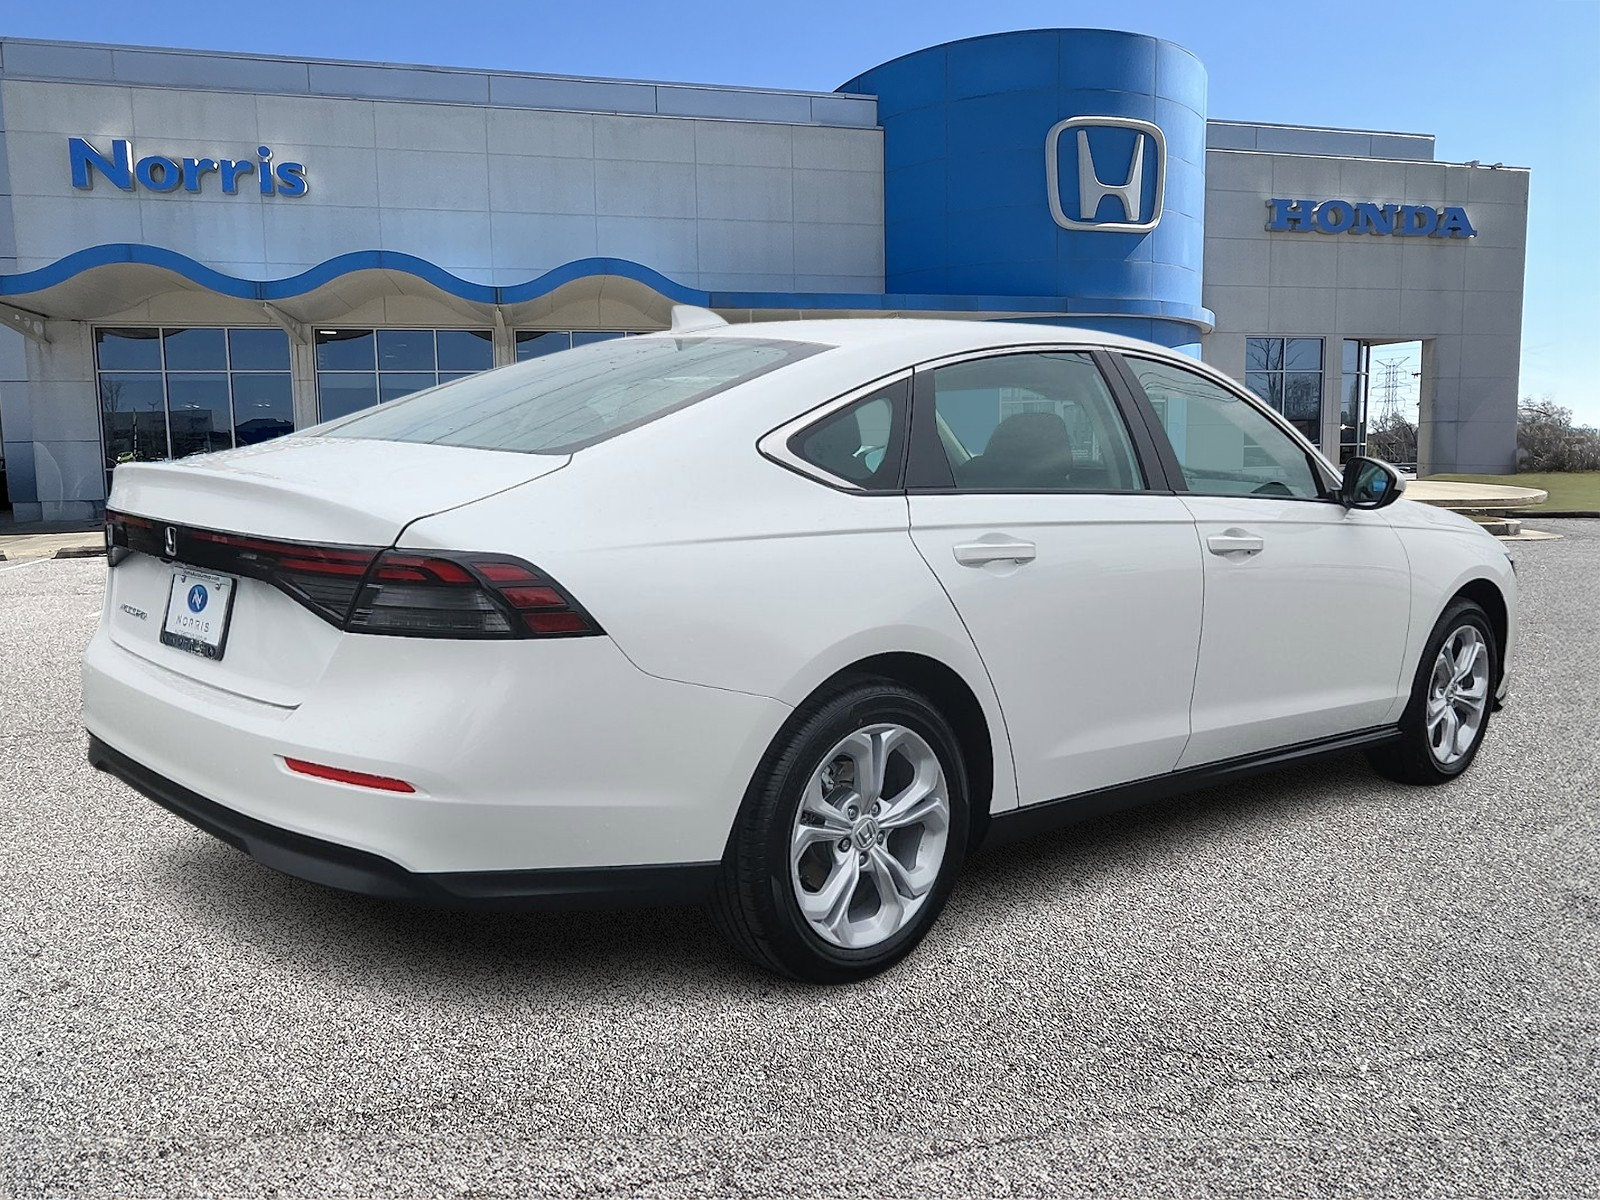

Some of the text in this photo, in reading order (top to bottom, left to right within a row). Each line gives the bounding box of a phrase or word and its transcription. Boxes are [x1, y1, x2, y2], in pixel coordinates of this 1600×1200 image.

[68, 137, 309, 197] Norris
[1265, 198, 1478, 239] HONDA
[175, 614, 211, 633] NORRIS
